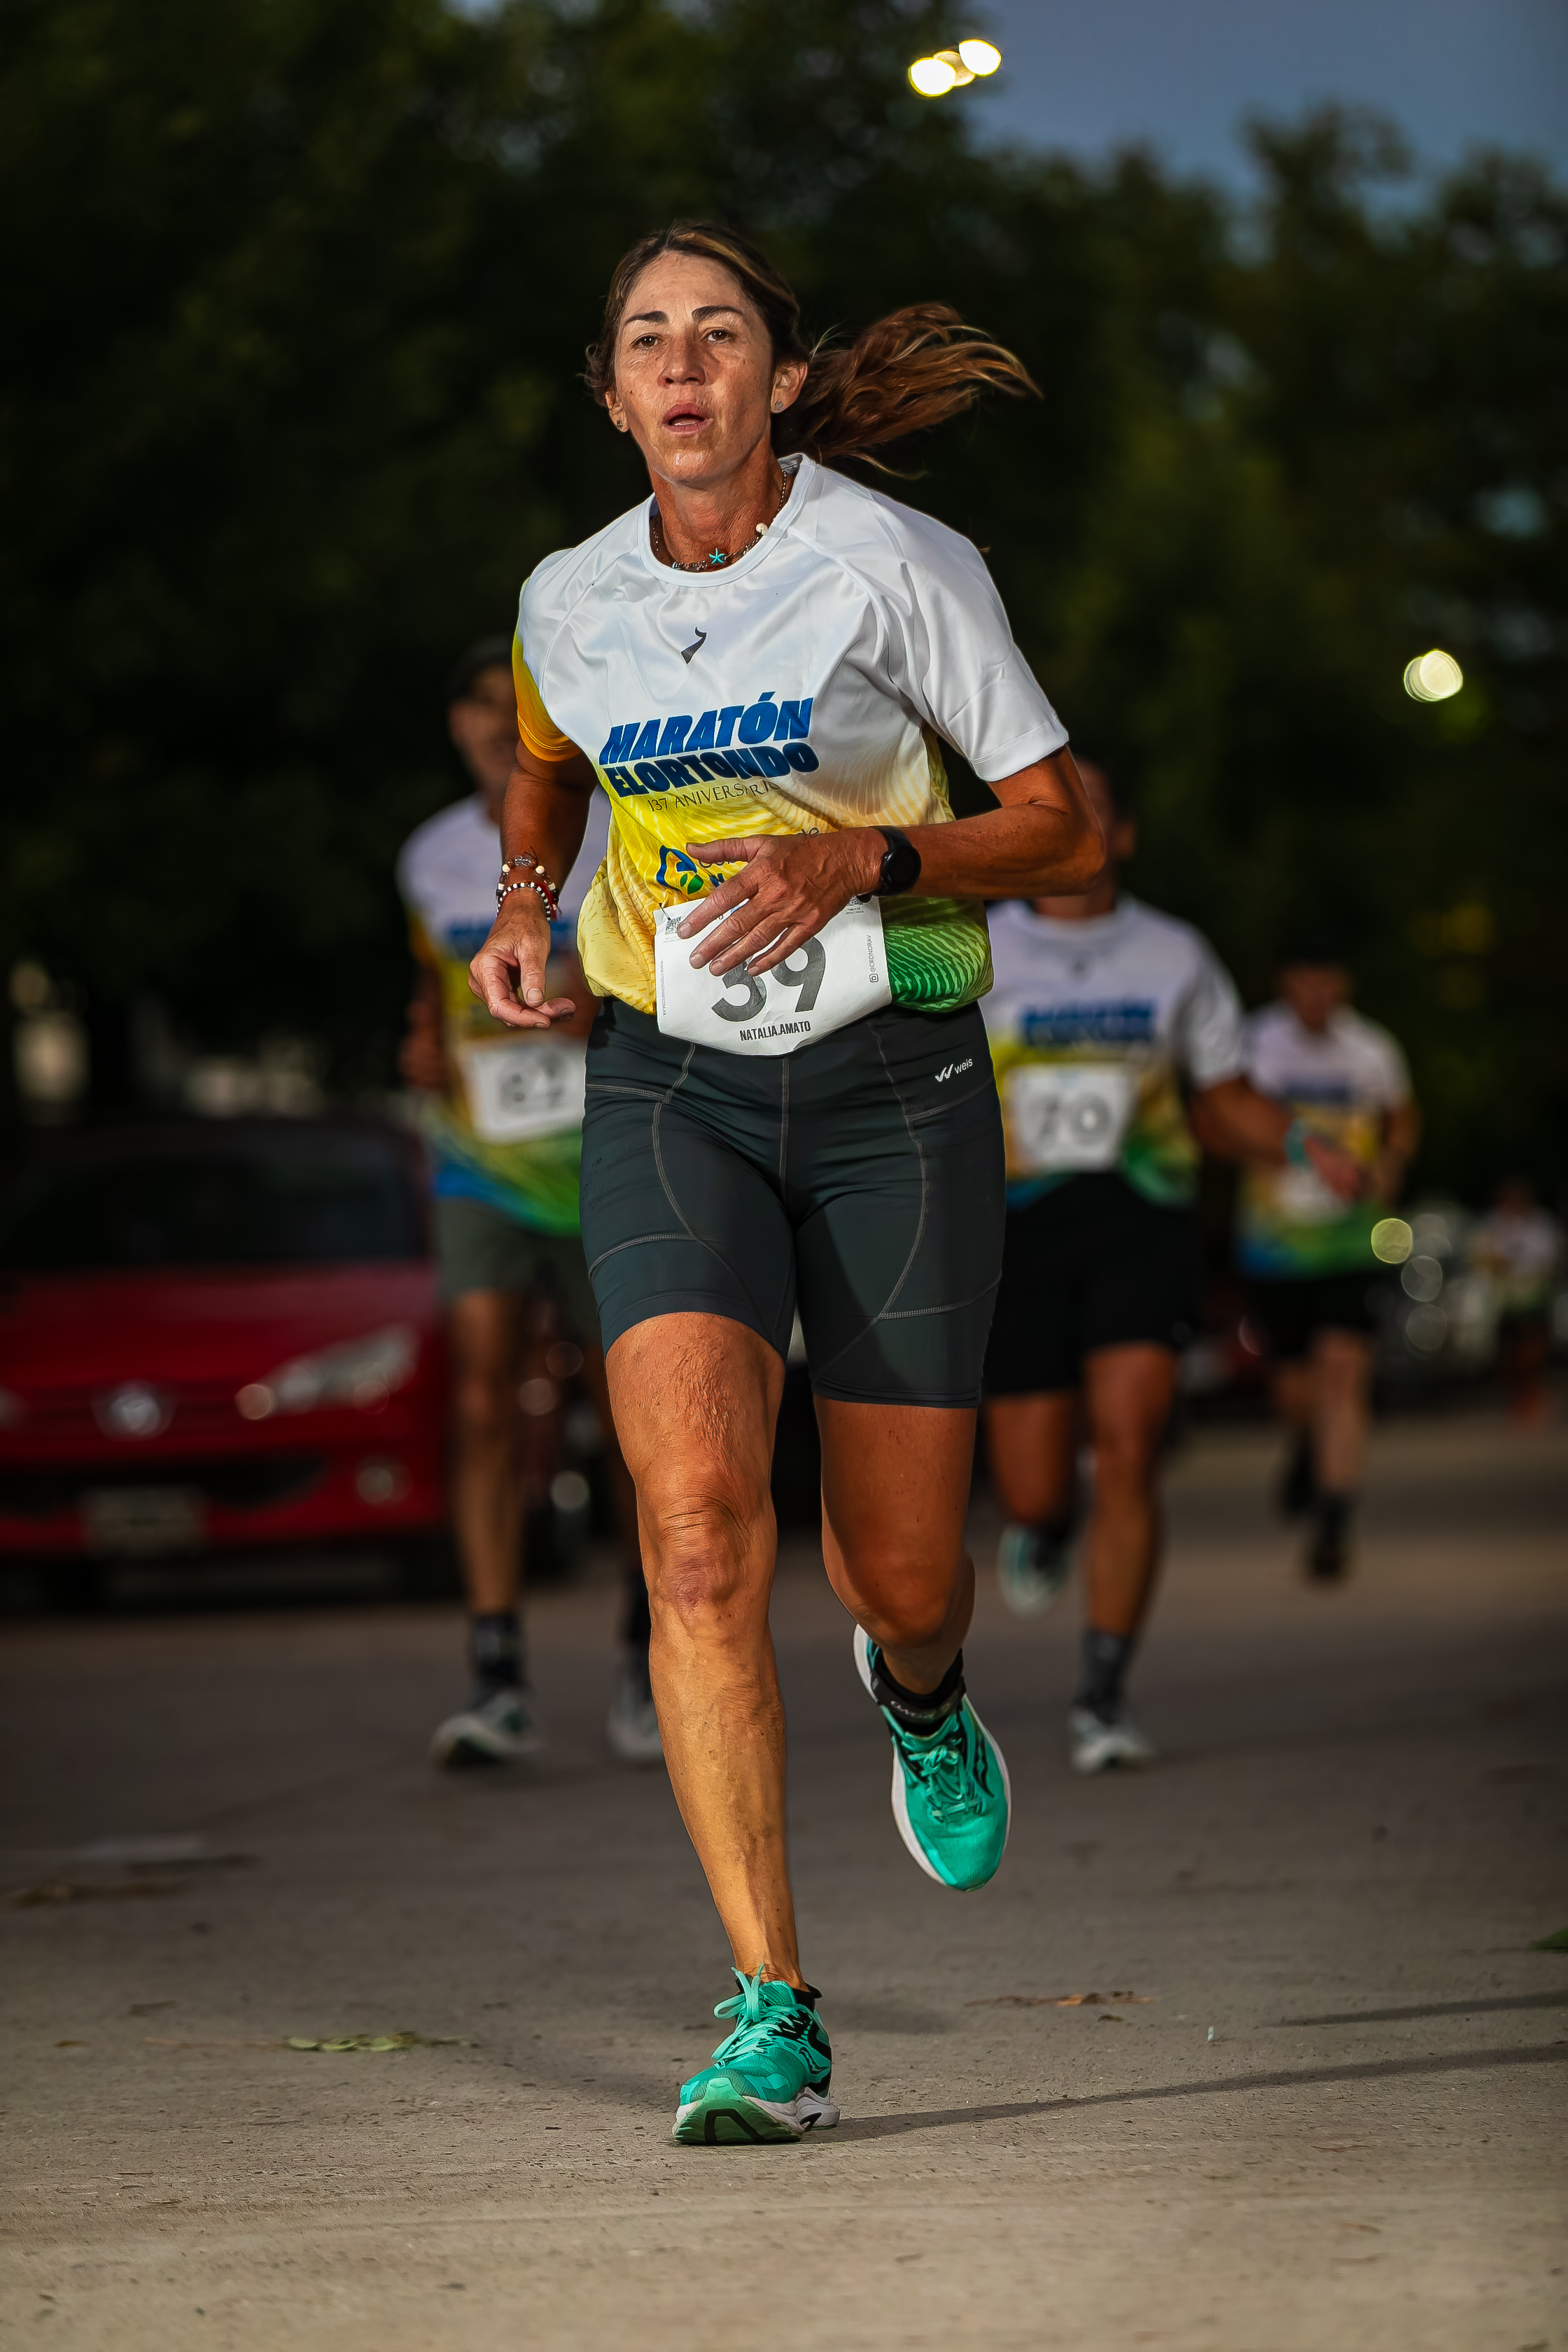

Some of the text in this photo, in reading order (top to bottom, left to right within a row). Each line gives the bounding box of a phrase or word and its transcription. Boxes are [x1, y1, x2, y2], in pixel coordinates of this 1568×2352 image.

[598, 691, 814, 765] MARATÓN
[603, 742, 819, 797] ELORTONDO
[646, 797, 668, 812] 137
[711, 937, 826, 1022] 39
[739, 1021, 811, 1042] NATALIA.AMATO
[954, 1058, 973, 1074] weis
